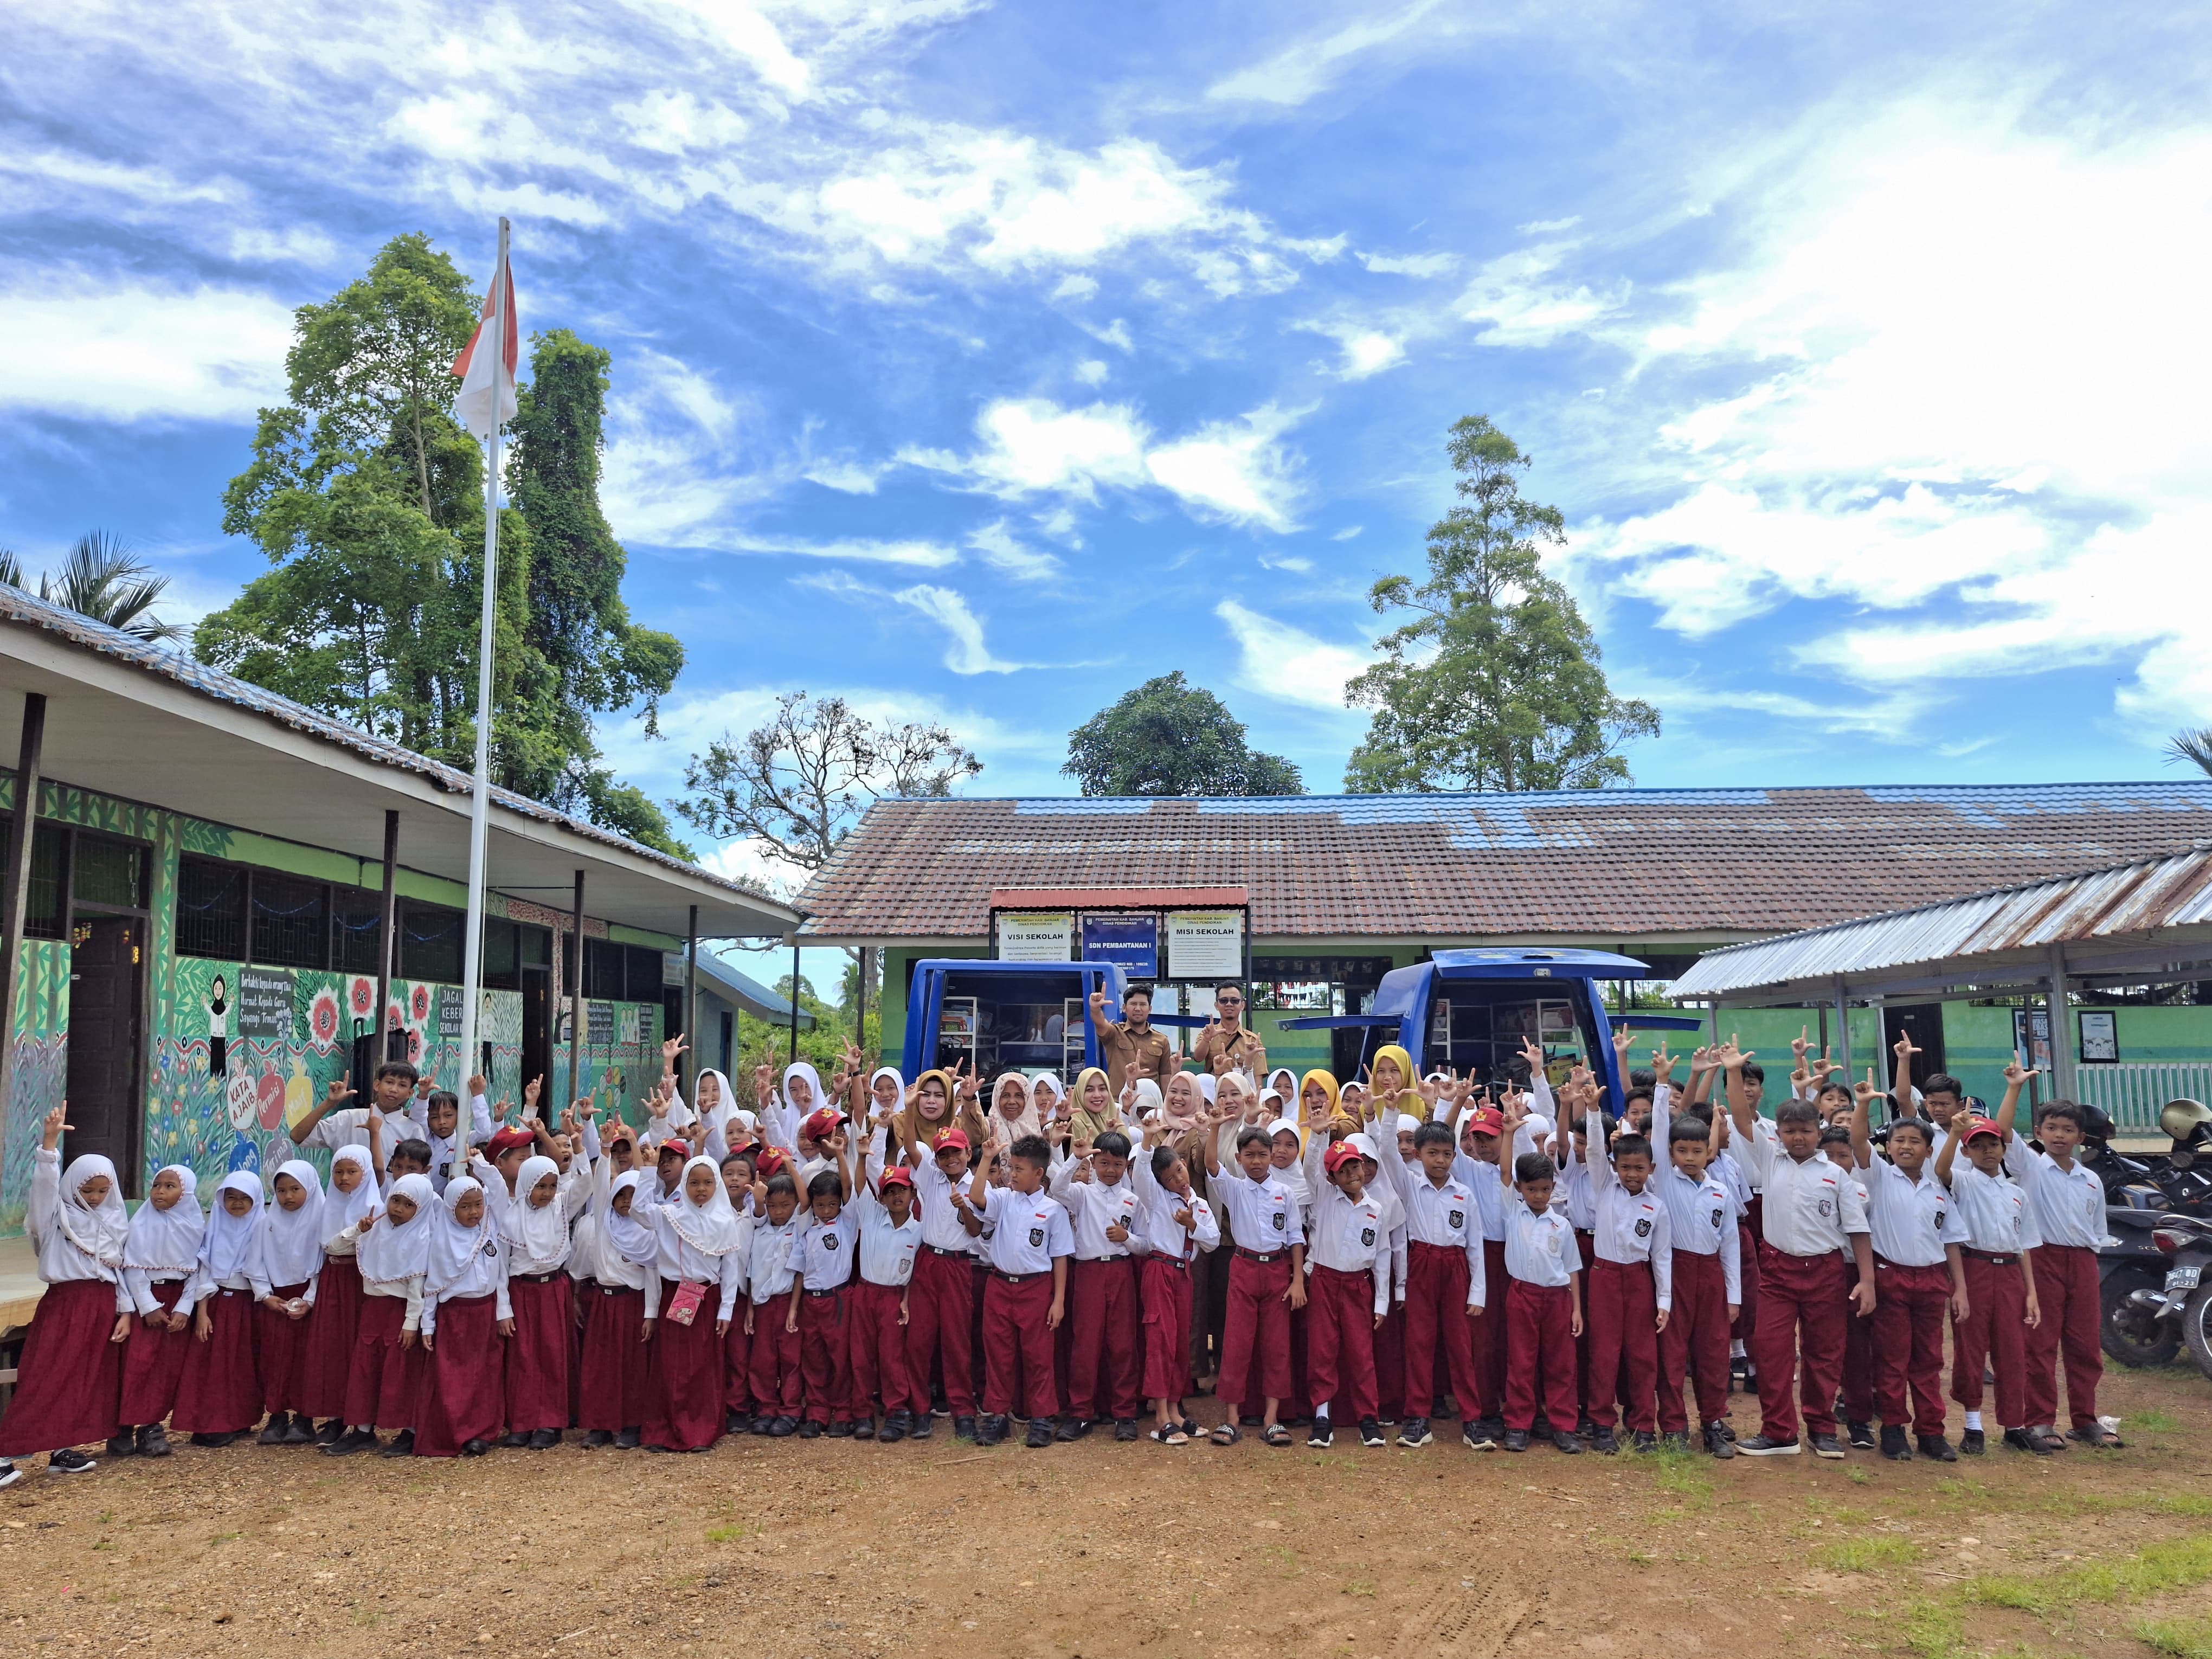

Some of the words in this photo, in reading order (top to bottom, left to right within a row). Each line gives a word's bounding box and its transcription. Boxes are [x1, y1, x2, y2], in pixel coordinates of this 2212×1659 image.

[241, 991, 258, 1006] Hormat
[258, 994, 273, 1010] Kepada
[274, 996, 286, 1007] Guru
[442, 990, 463, 1004] JAGAL
[240, 1008, 260, 1028] Sayangi
[261, 1012, 277, 1024] Teman
[442, 1007, 463, 1019] KEBER
[439, 1021, 459, 1034] SEKOLAH
[230, 1079, 249, 1104] KATA
[258, 1081, 280, 1117] Permisi
[288, 1086, 307, 1116] Maaf
[233, 1092, 255, 1122] AJAIB
[232, 1148, 258, 1172] long
[263, 1141, 288, 1176] Terima
